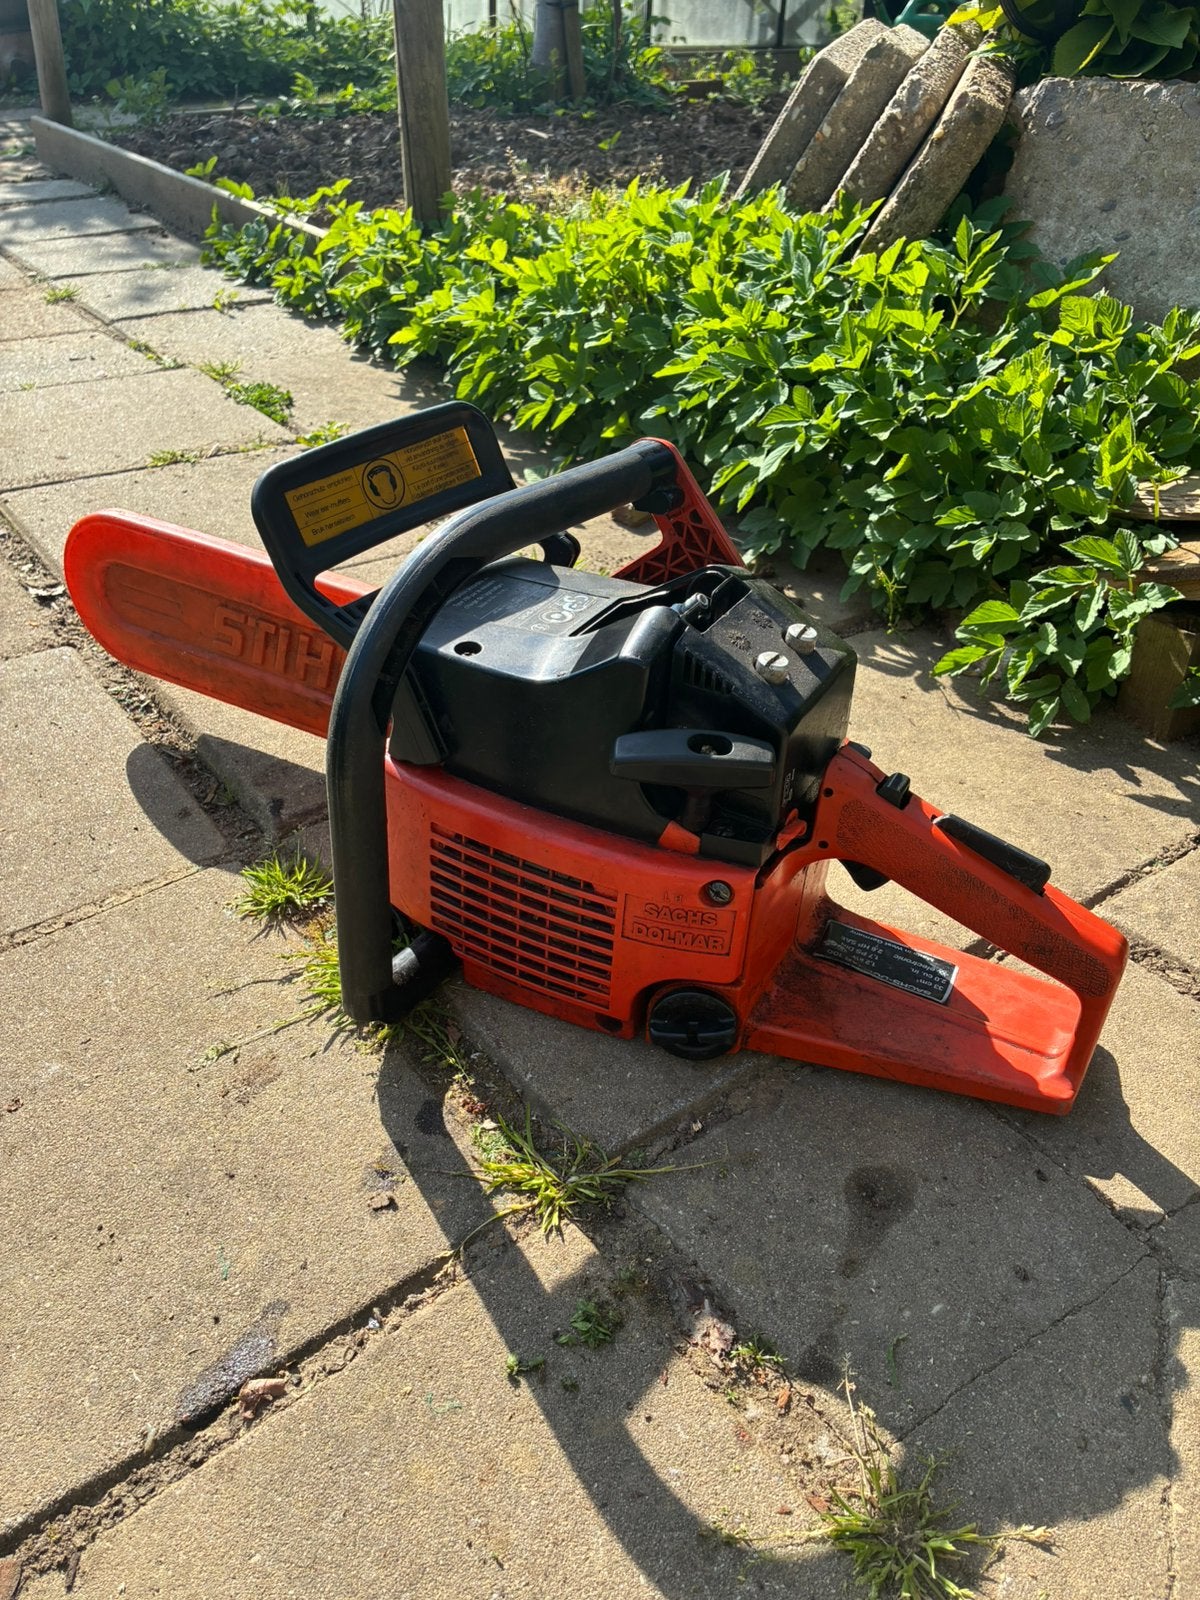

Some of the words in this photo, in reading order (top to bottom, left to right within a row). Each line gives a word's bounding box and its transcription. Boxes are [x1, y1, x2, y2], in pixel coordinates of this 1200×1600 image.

[212, 605, 340, 690] STIH
[644, 902, 718, 926] SACHS
[632, 921, 725, 951] DOLMAR
